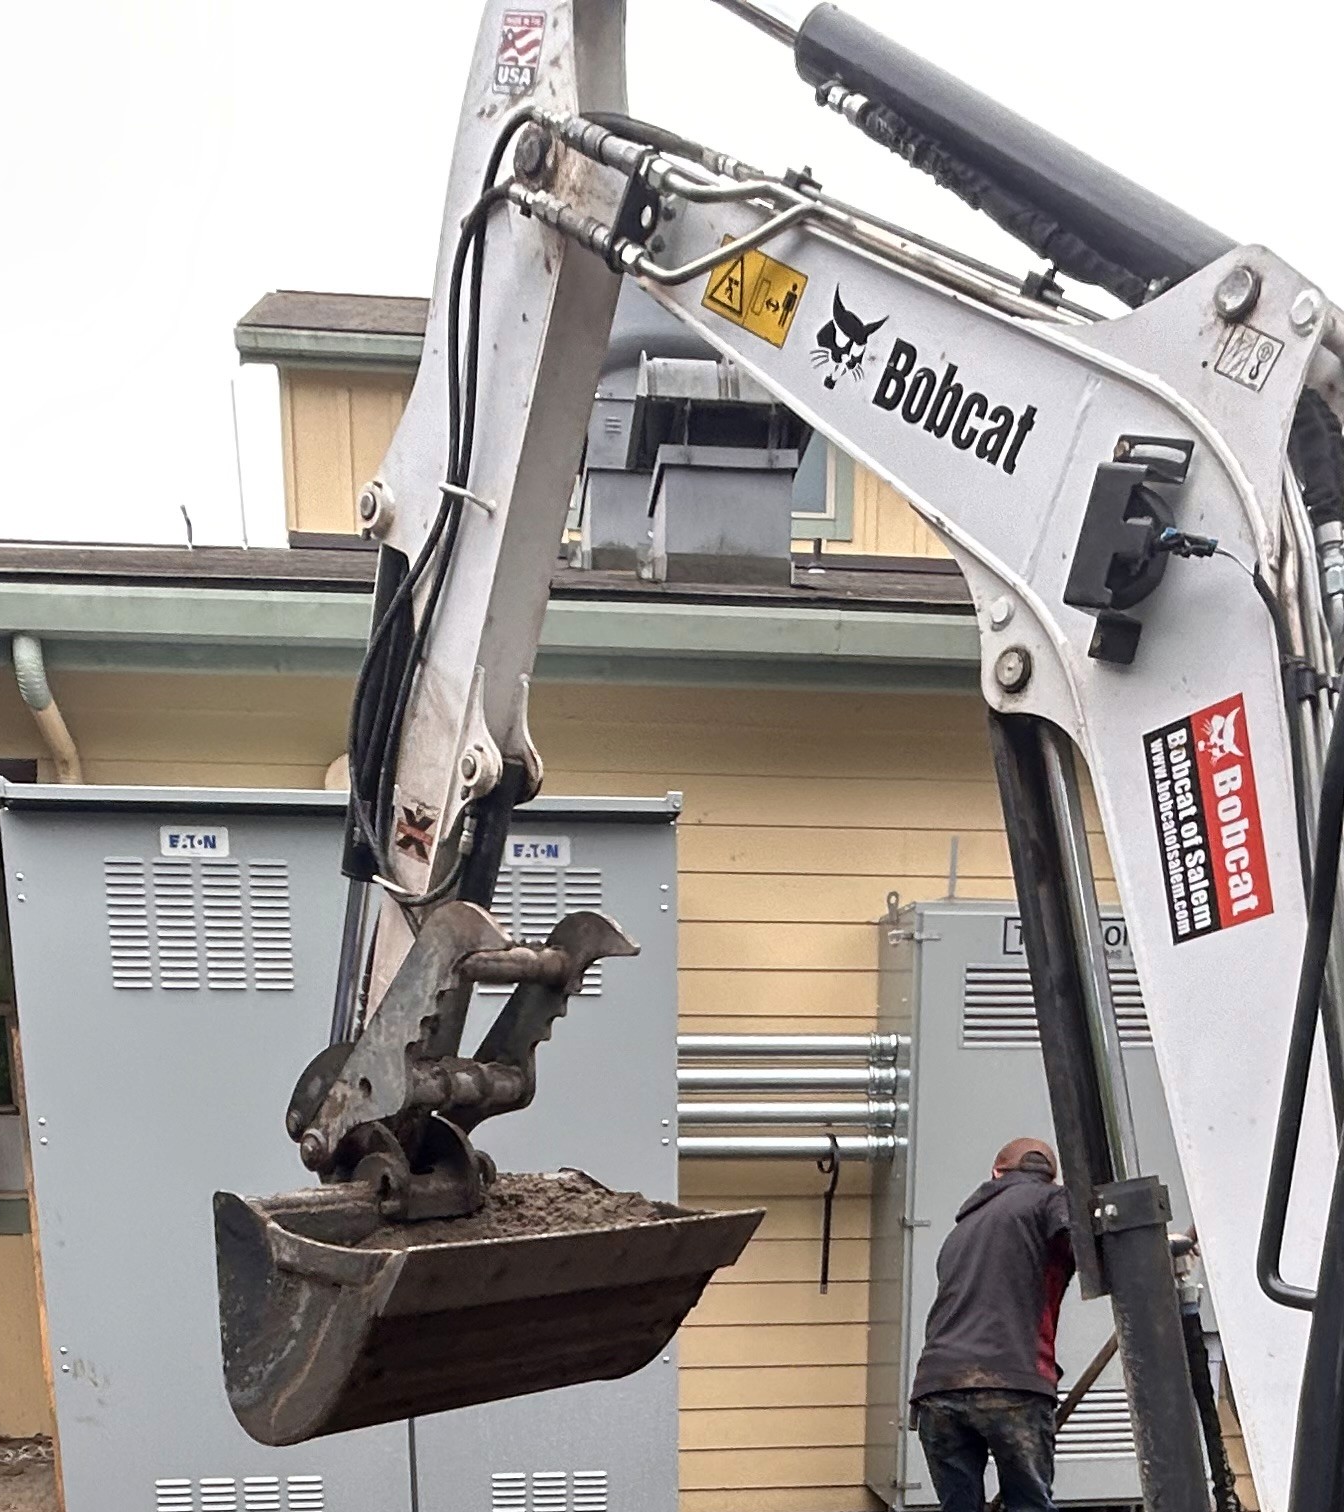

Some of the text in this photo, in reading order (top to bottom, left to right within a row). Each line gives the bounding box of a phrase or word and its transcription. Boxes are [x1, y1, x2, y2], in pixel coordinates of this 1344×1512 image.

[497, 66, 531, 86] USA
[872, 337, 1038, 476] Bobcat
[1150, 737, 1191, 936] www.bobcatofsalem.com
[1167, 727, 1212, 931] Bobcat of Salem
[1212, 764, 1259, 916] Bobcat
